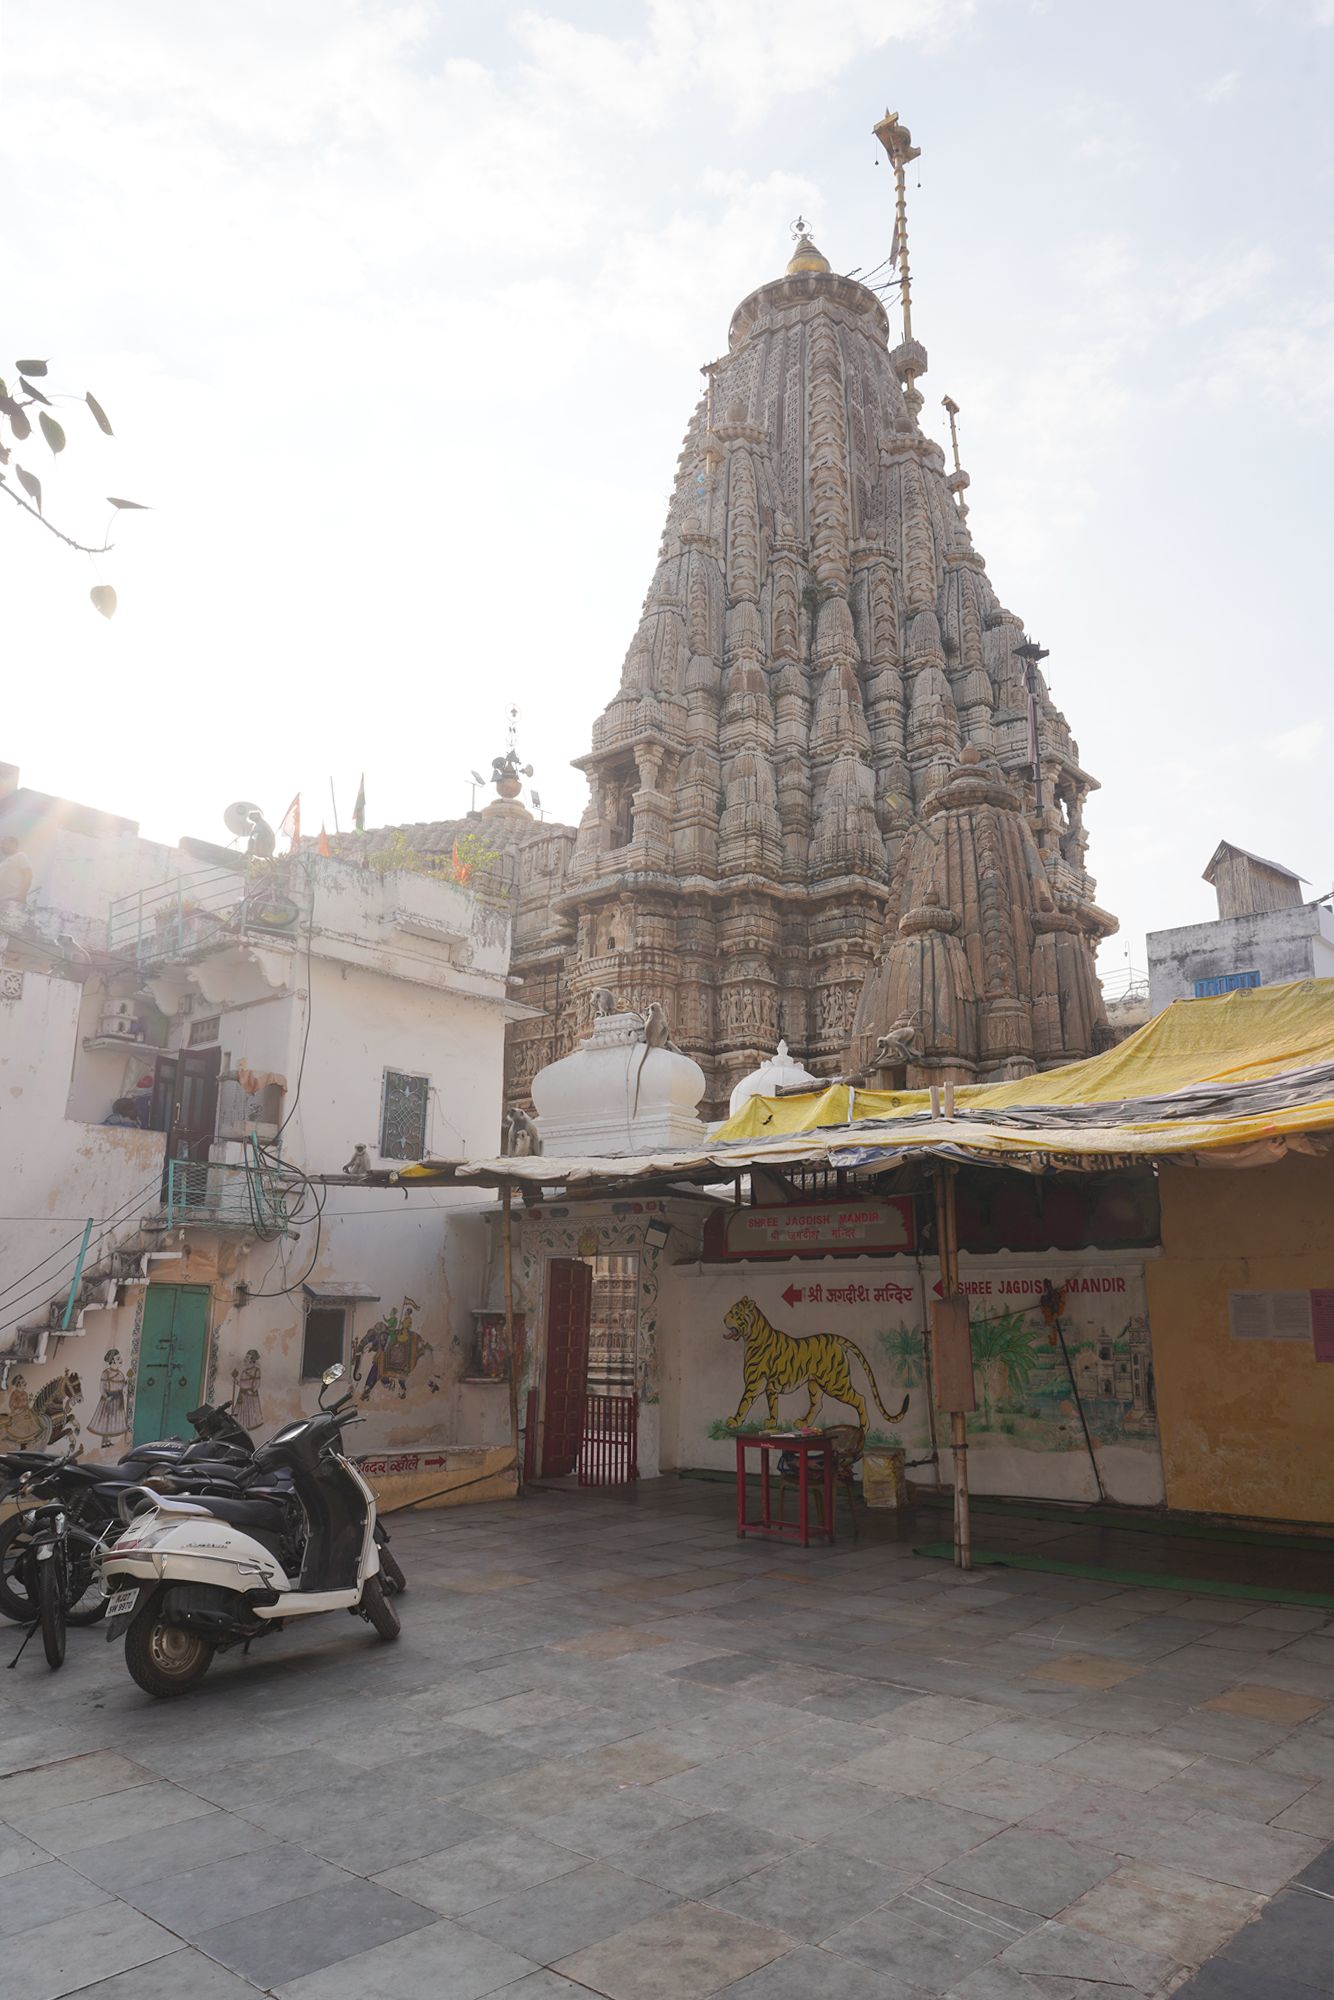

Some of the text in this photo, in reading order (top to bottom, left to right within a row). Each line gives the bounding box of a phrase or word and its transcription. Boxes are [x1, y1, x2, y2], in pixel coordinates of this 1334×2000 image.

[748, 1212, 880, 1228] SHREE JAGDISH MANDIR
[808, 1282, 913, 1304] श्री जगदीश मन्दिर
[957, 1281, 992, 1295] SHREE
[1065, 1277, 1126, 1293] MANDIR
